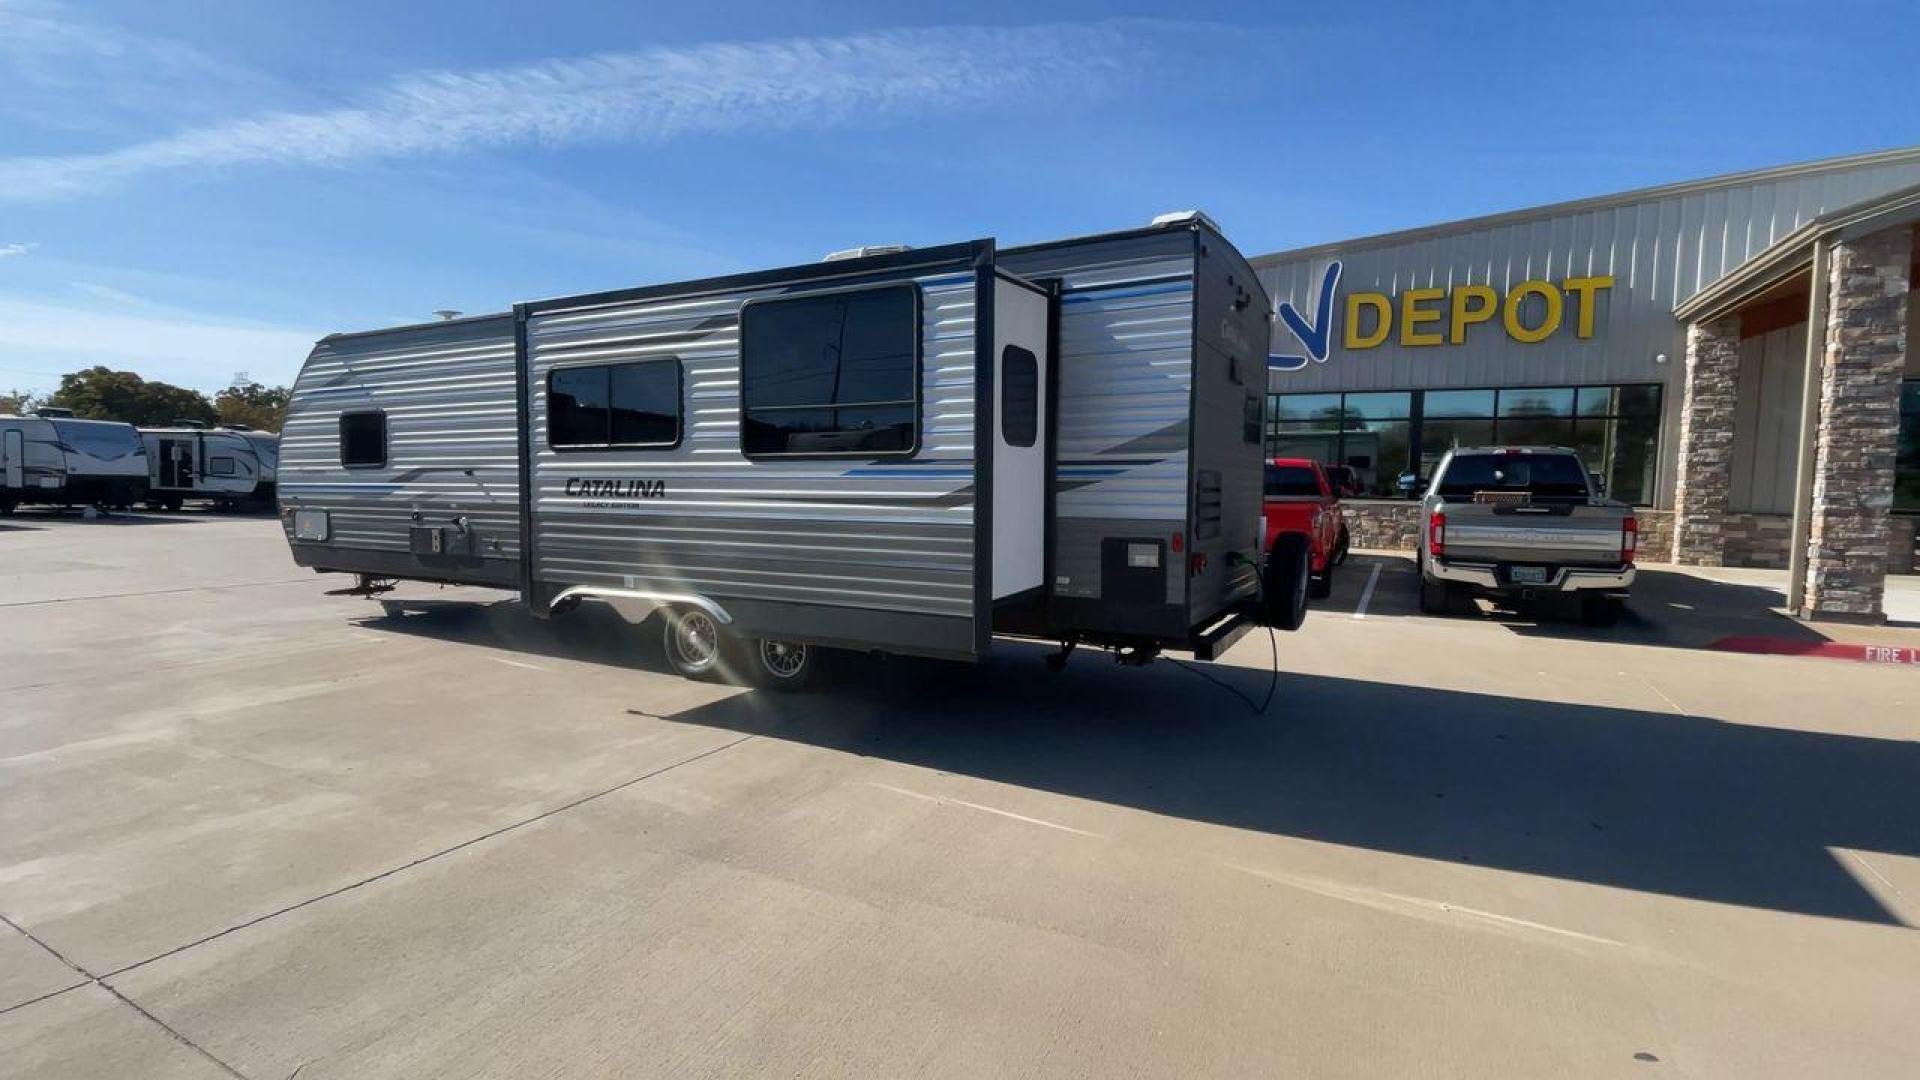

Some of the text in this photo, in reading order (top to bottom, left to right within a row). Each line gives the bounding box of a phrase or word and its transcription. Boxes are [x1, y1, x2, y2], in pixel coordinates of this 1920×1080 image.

[1344, 275, 1615, 350] DEPOT
[565, 477, 666, 498] CATALINA
[1865, 647, 1902, 662] FIRE
